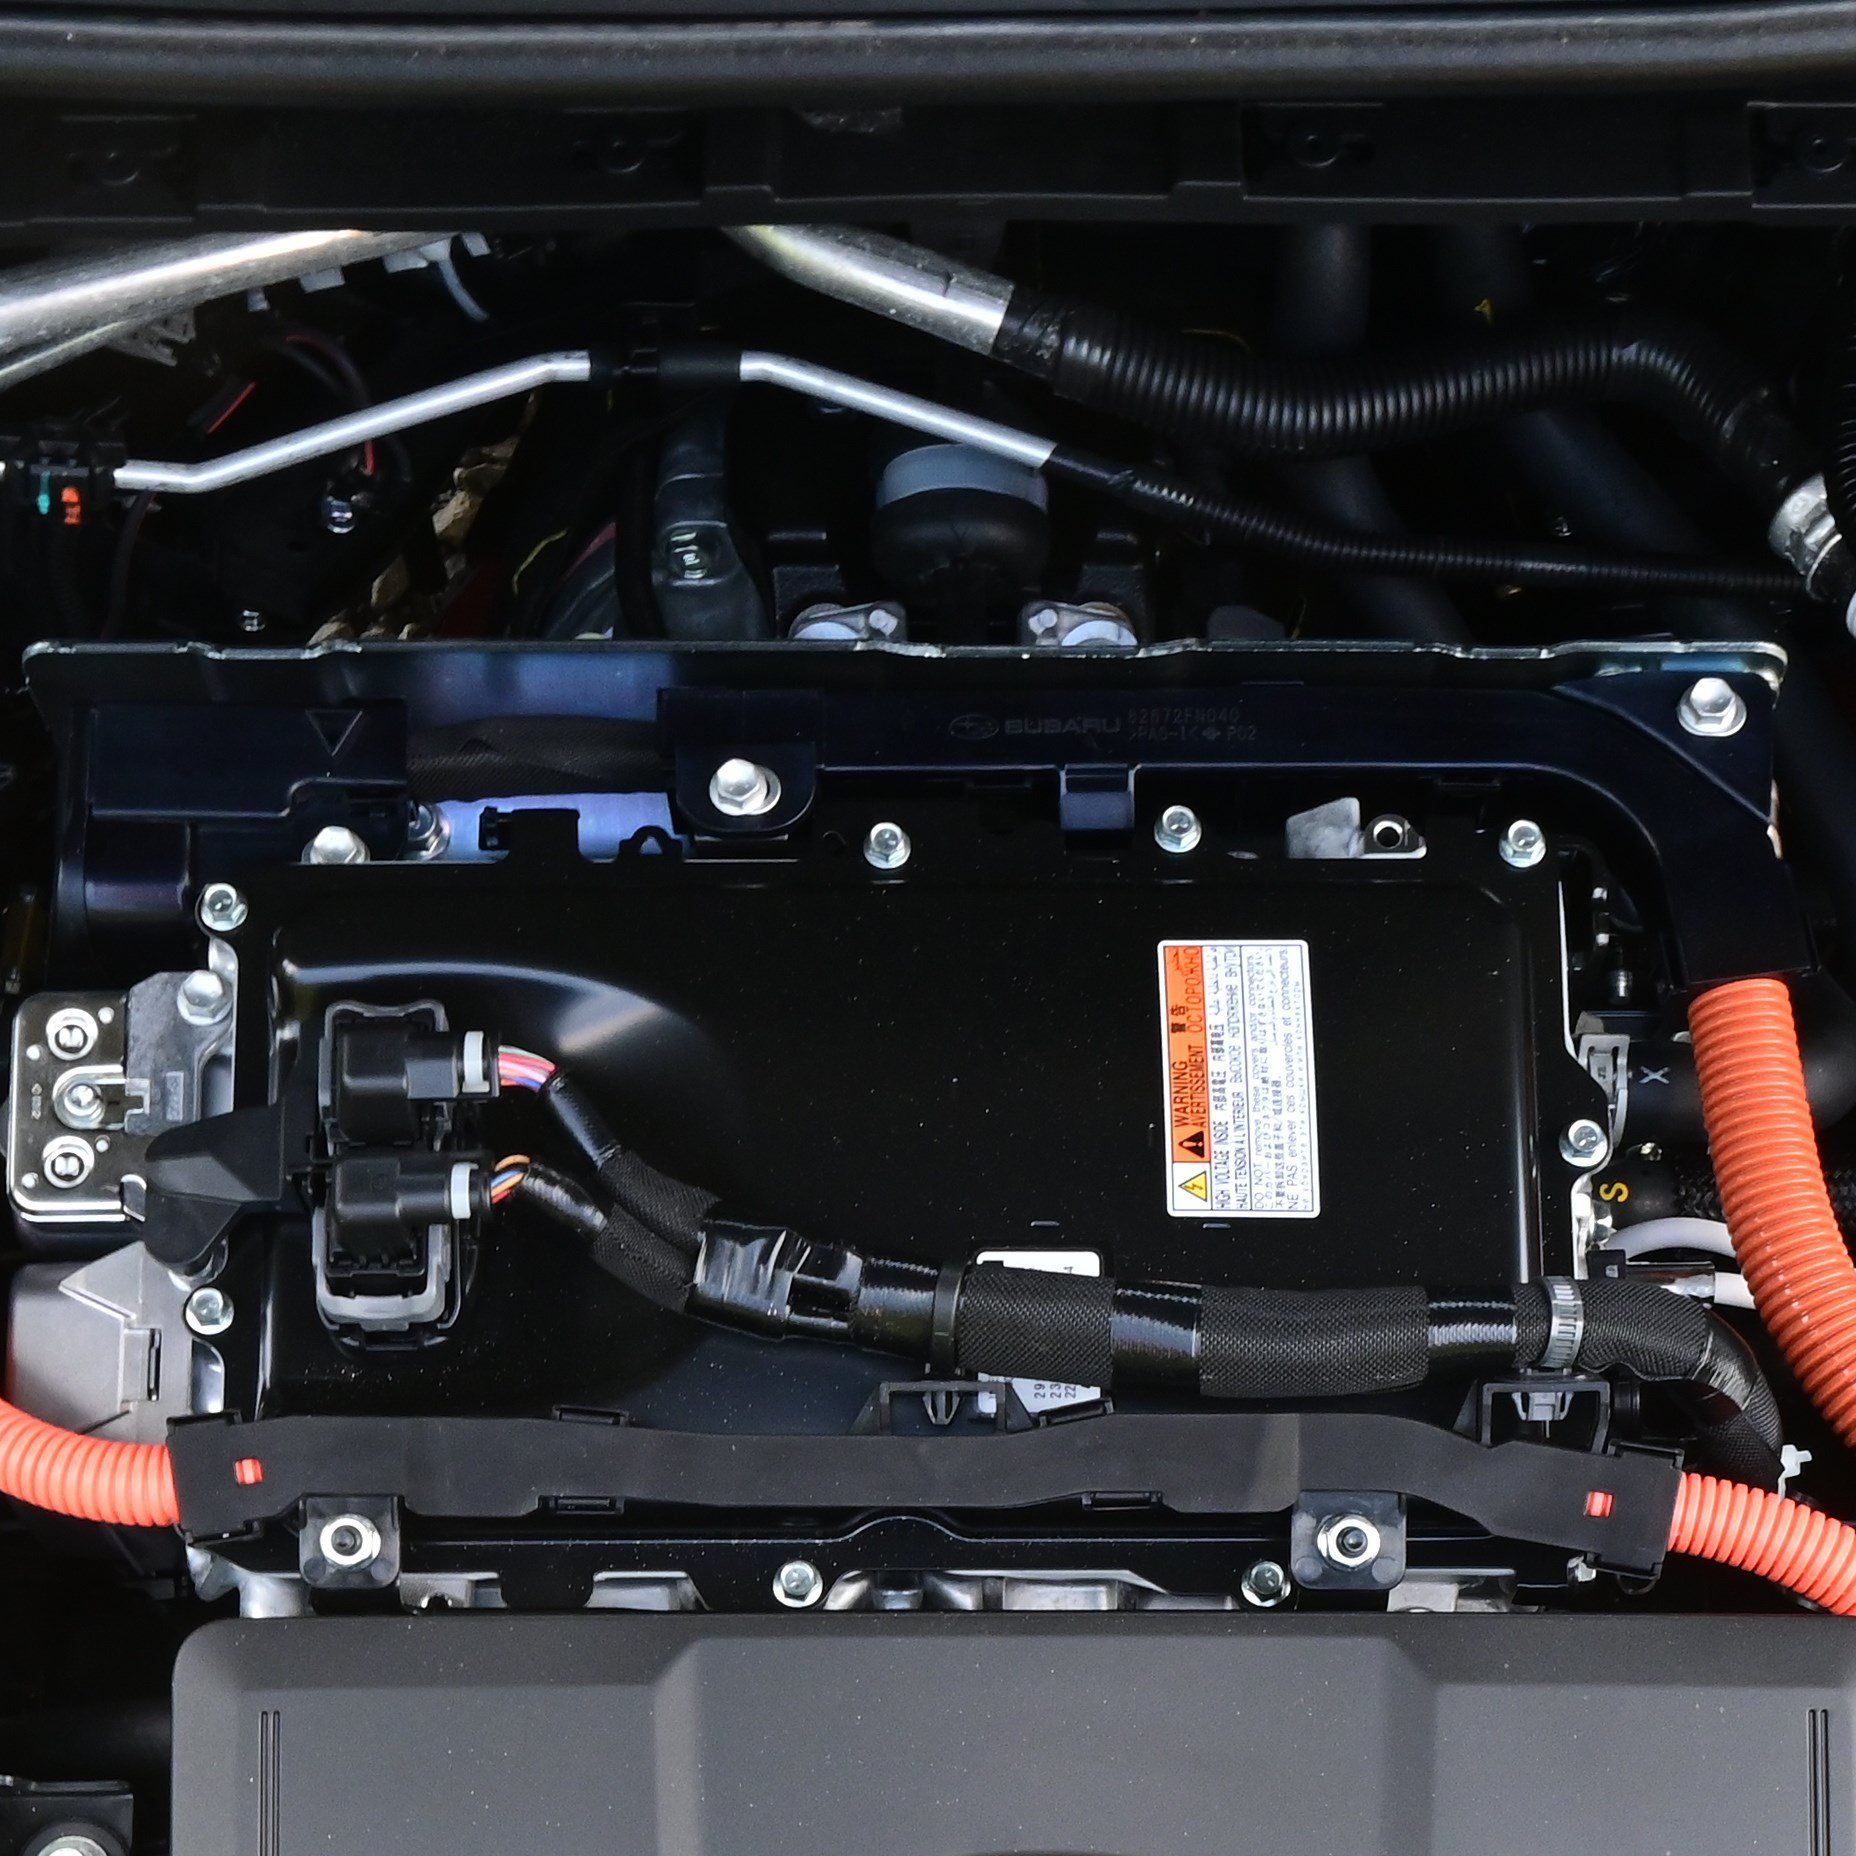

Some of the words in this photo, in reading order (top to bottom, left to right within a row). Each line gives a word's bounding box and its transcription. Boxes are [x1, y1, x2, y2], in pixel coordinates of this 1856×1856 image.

[1247, 1012, 1257, 1041] and/or
[1281, 1016, 1291, 1025] et
[1250, 1047, 1259, 1079] covers
[1281, 1032, 1293, 1087] couvercles
[1171, 1060, 1189, 1127] WARNING
[1187, 1044, 1206, 1127] AVERTISSEMENT
[1250, 1086, 1260, 1111] these
[1285, 1094, 1294, 1112] ces
[1212, 1120, 1228, 1145] INSIDE
[1252, 1119, 1262, 1155] remove
[1285, 1119, 1296, 1157] enlever
[1213, 1150, 1230, 1184] VOLTAGE
[1232, 1147, 1247, 1179] TENSION
[1253, 1163, 1263, 1184] NOT
[1286, 1164, 1297, 1186] PAS
[1215, 1189, 1230, 1208] HIGH
[1234, 1183, 1248, 1208] HAUTE
[1254, 1192, 1264, 1208] DO
[1287, 1193, 1298, 1208] NE
[1599, 1182, 1628, 1202] S
[1034, 1383, 1045, 1398] 29
